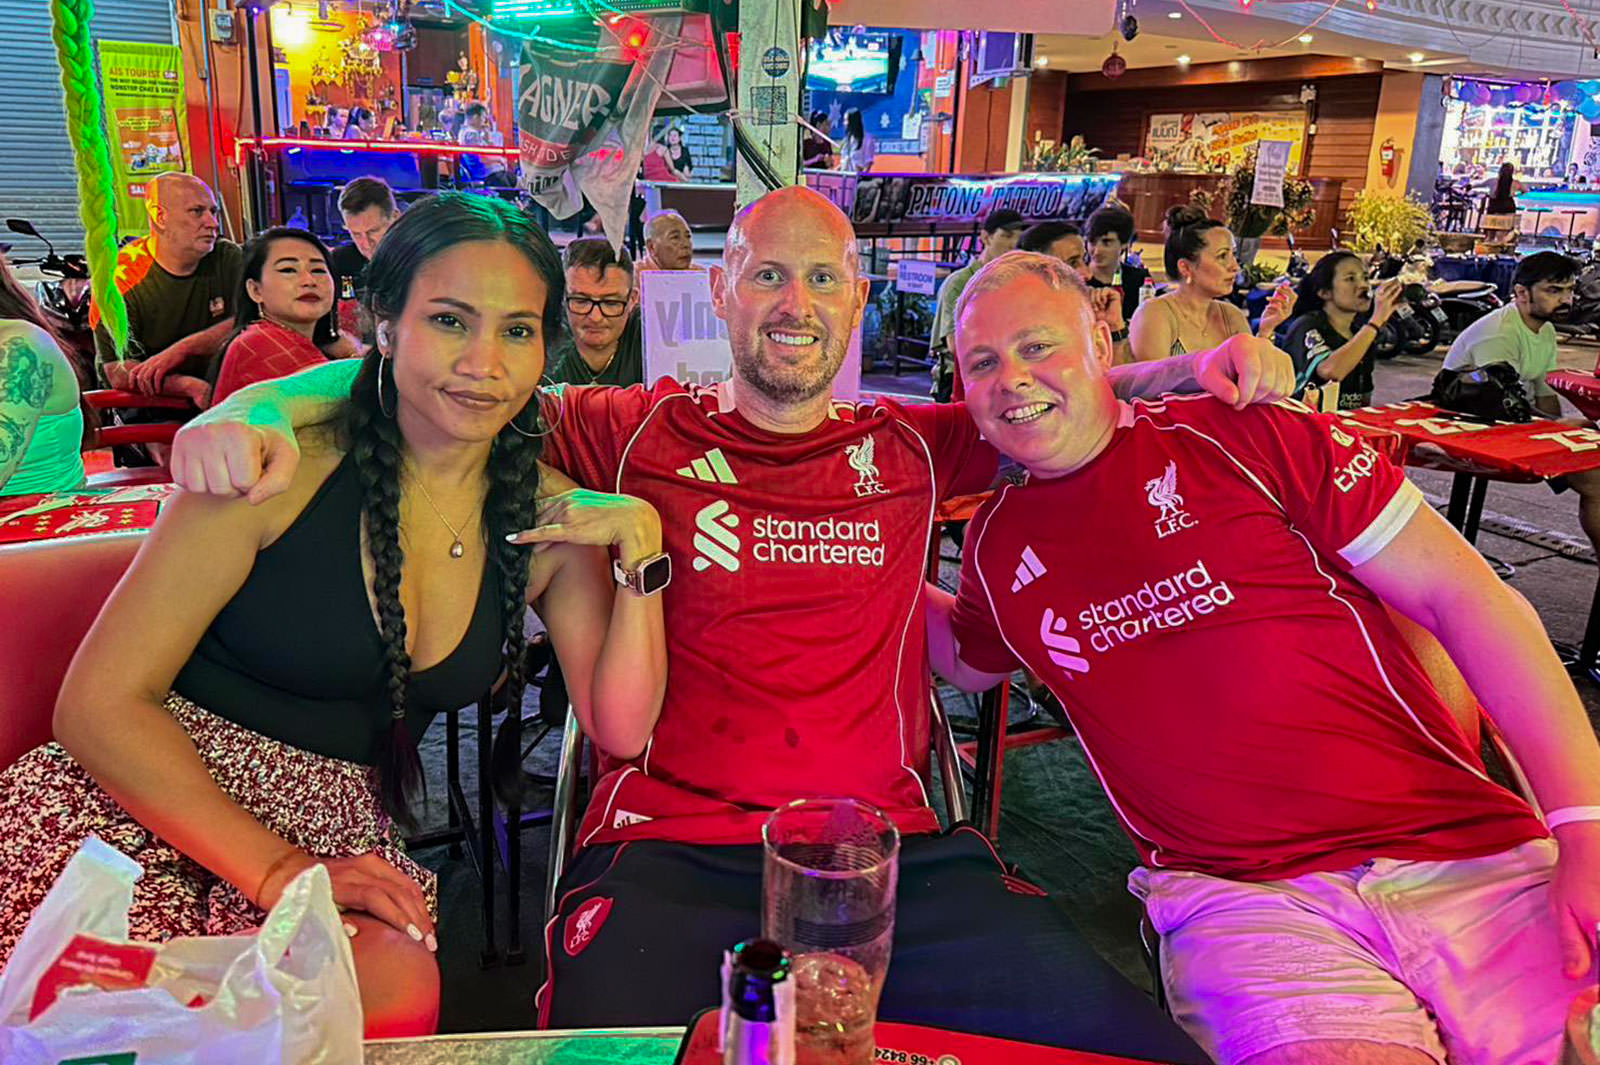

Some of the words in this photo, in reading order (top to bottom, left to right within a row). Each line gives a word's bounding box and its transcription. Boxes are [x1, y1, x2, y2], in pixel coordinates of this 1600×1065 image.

[124, 68, 160, 78] TOURIST
[139, 85, 155, 93] CHAT
[520, 66, 611, 130] AGNER
[906, 184, 985, 217] PATONG
[990, 183, 1063, 217] TATTOO
[752, 514, 880, 542] standard
[1154, 512, 1199, 539] L.F.C.
[752, 539, 886, 567] chartered
[1078, 559, 1213, 631] standard
[1090, 580, 1235, 652] chartered
